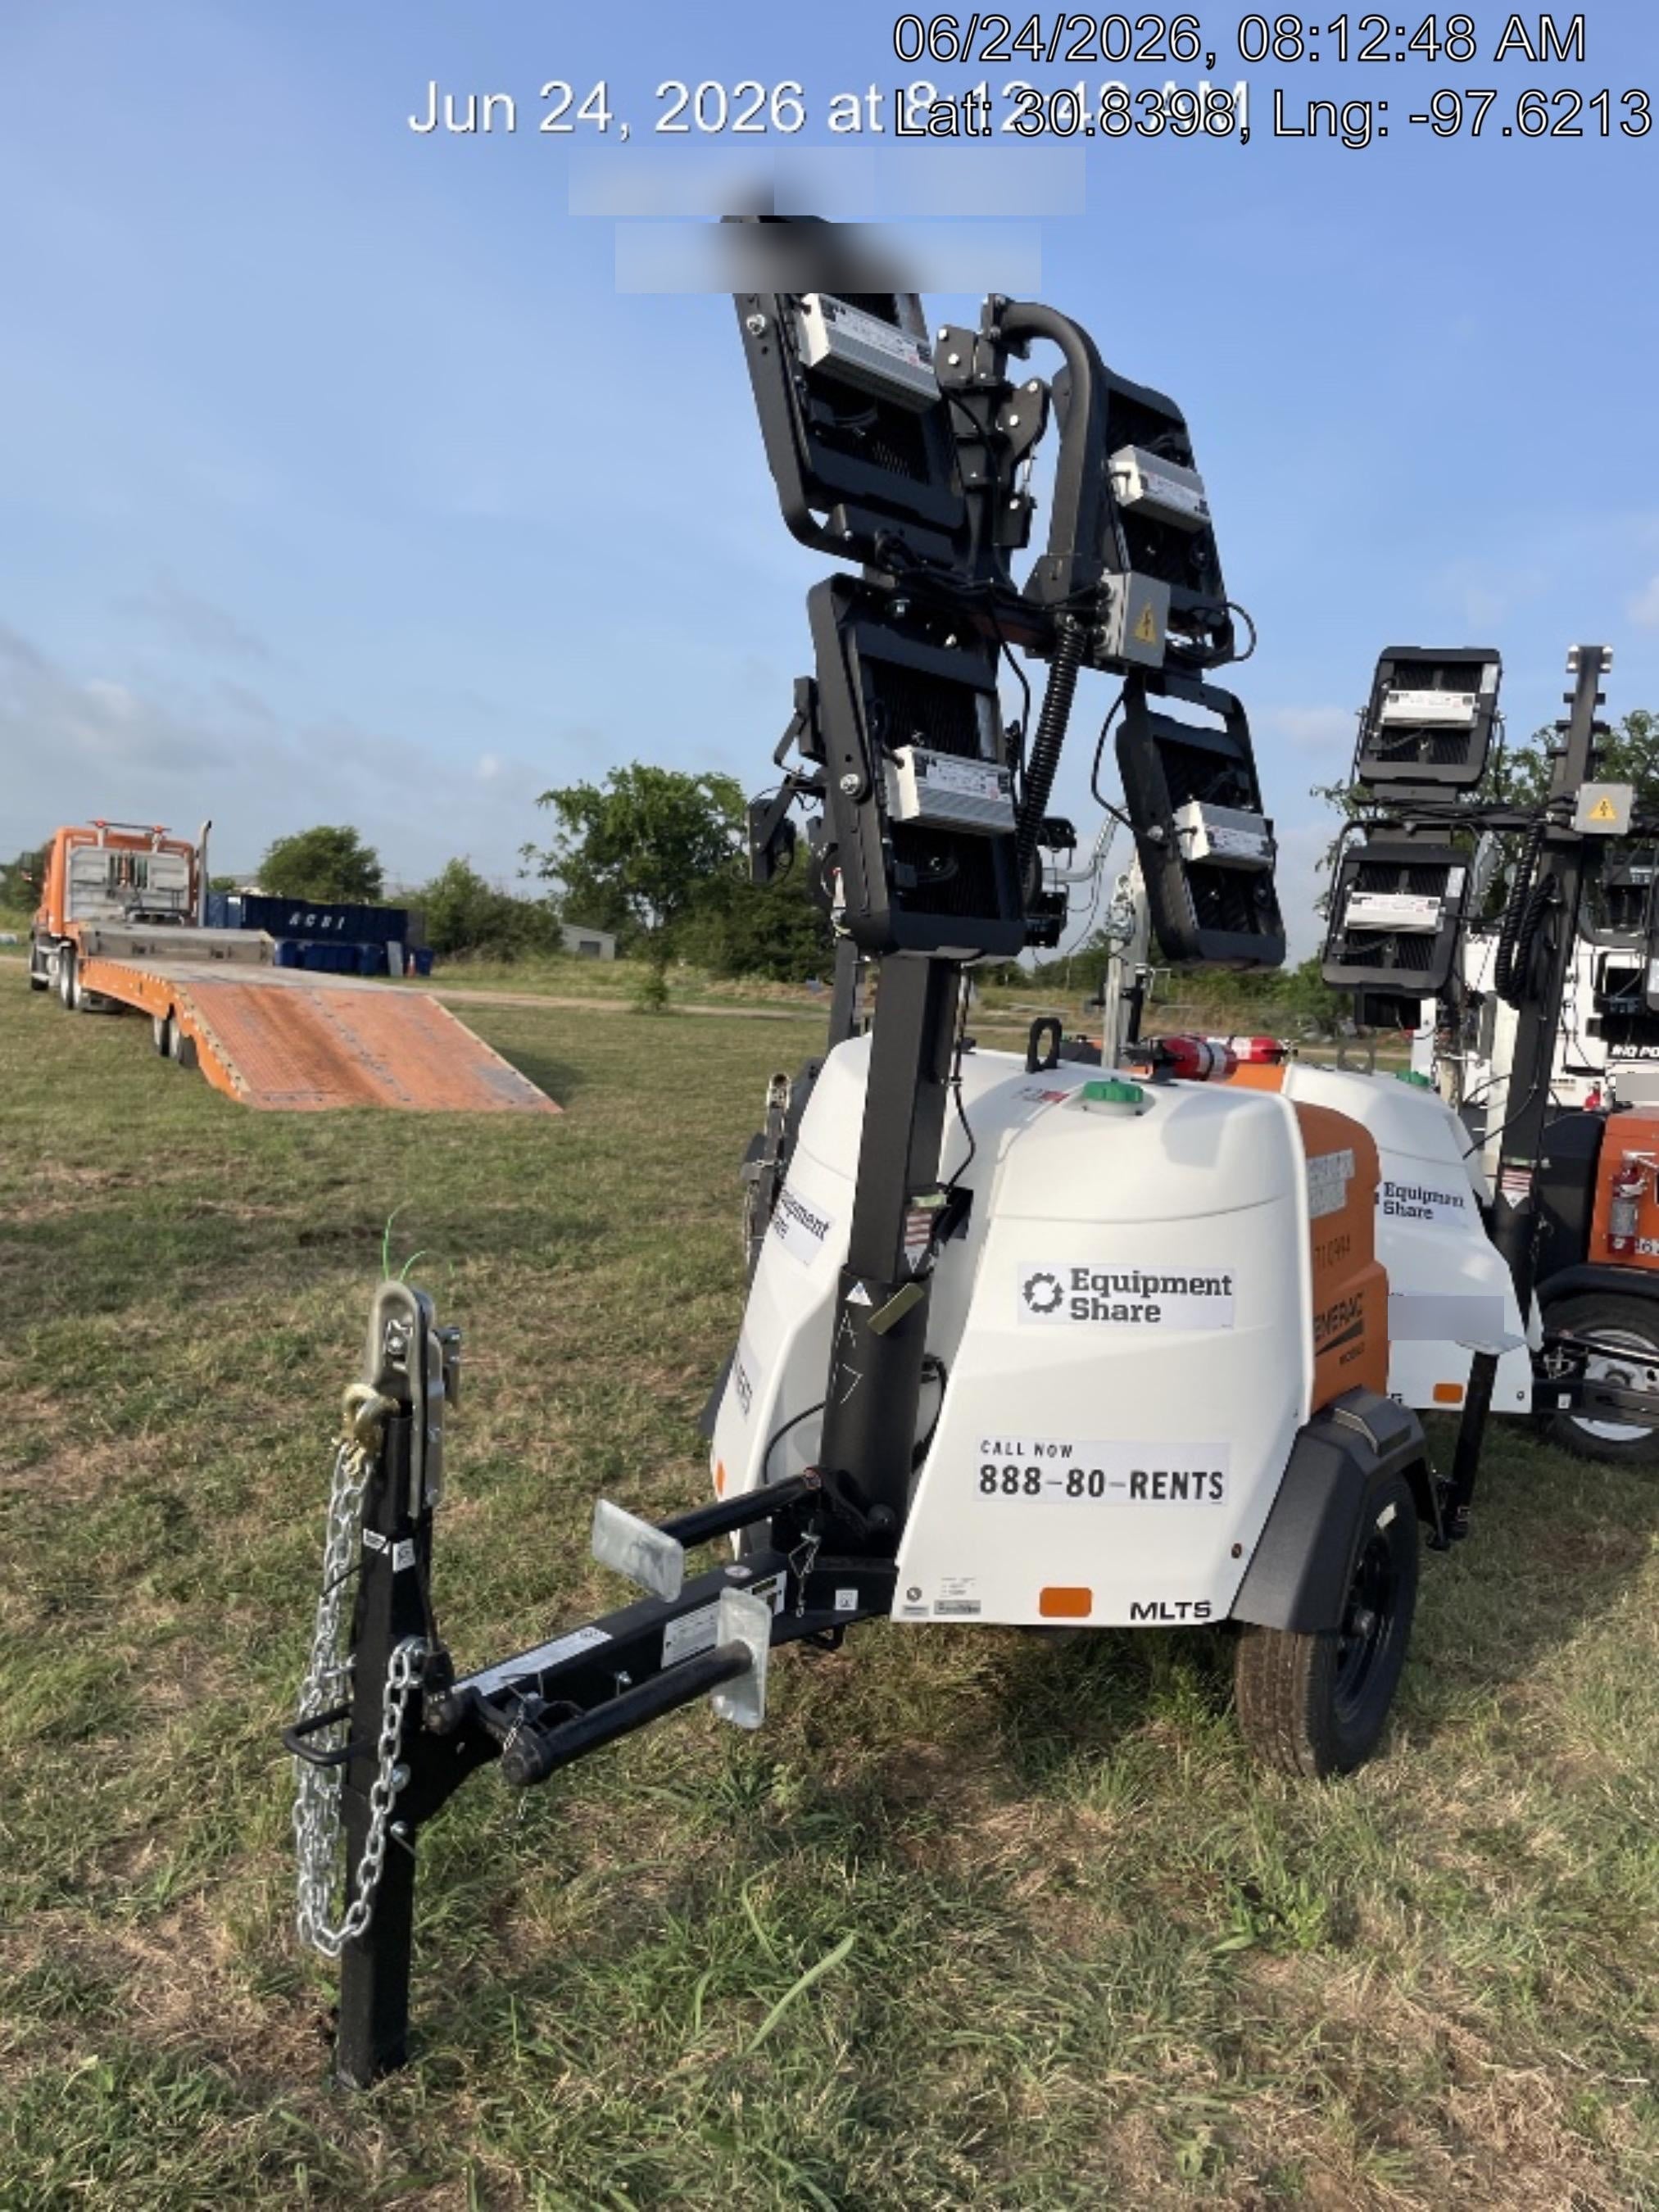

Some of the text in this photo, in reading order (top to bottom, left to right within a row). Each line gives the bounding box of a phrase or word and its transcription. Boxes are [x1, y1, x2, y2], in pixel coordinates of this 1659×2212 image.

[1383, 1199, 1435, 1220] Share
[1070, 1267, 1233, 1299] Equipment
[1070, 1297, 1163, 1323] Share
[1312, 1291, 1364, 1343] ENERAC
[981, 1439, 1073, 1459] CALL NOW
[980, 1464, 1223, 1500] 888-80-RENTS
